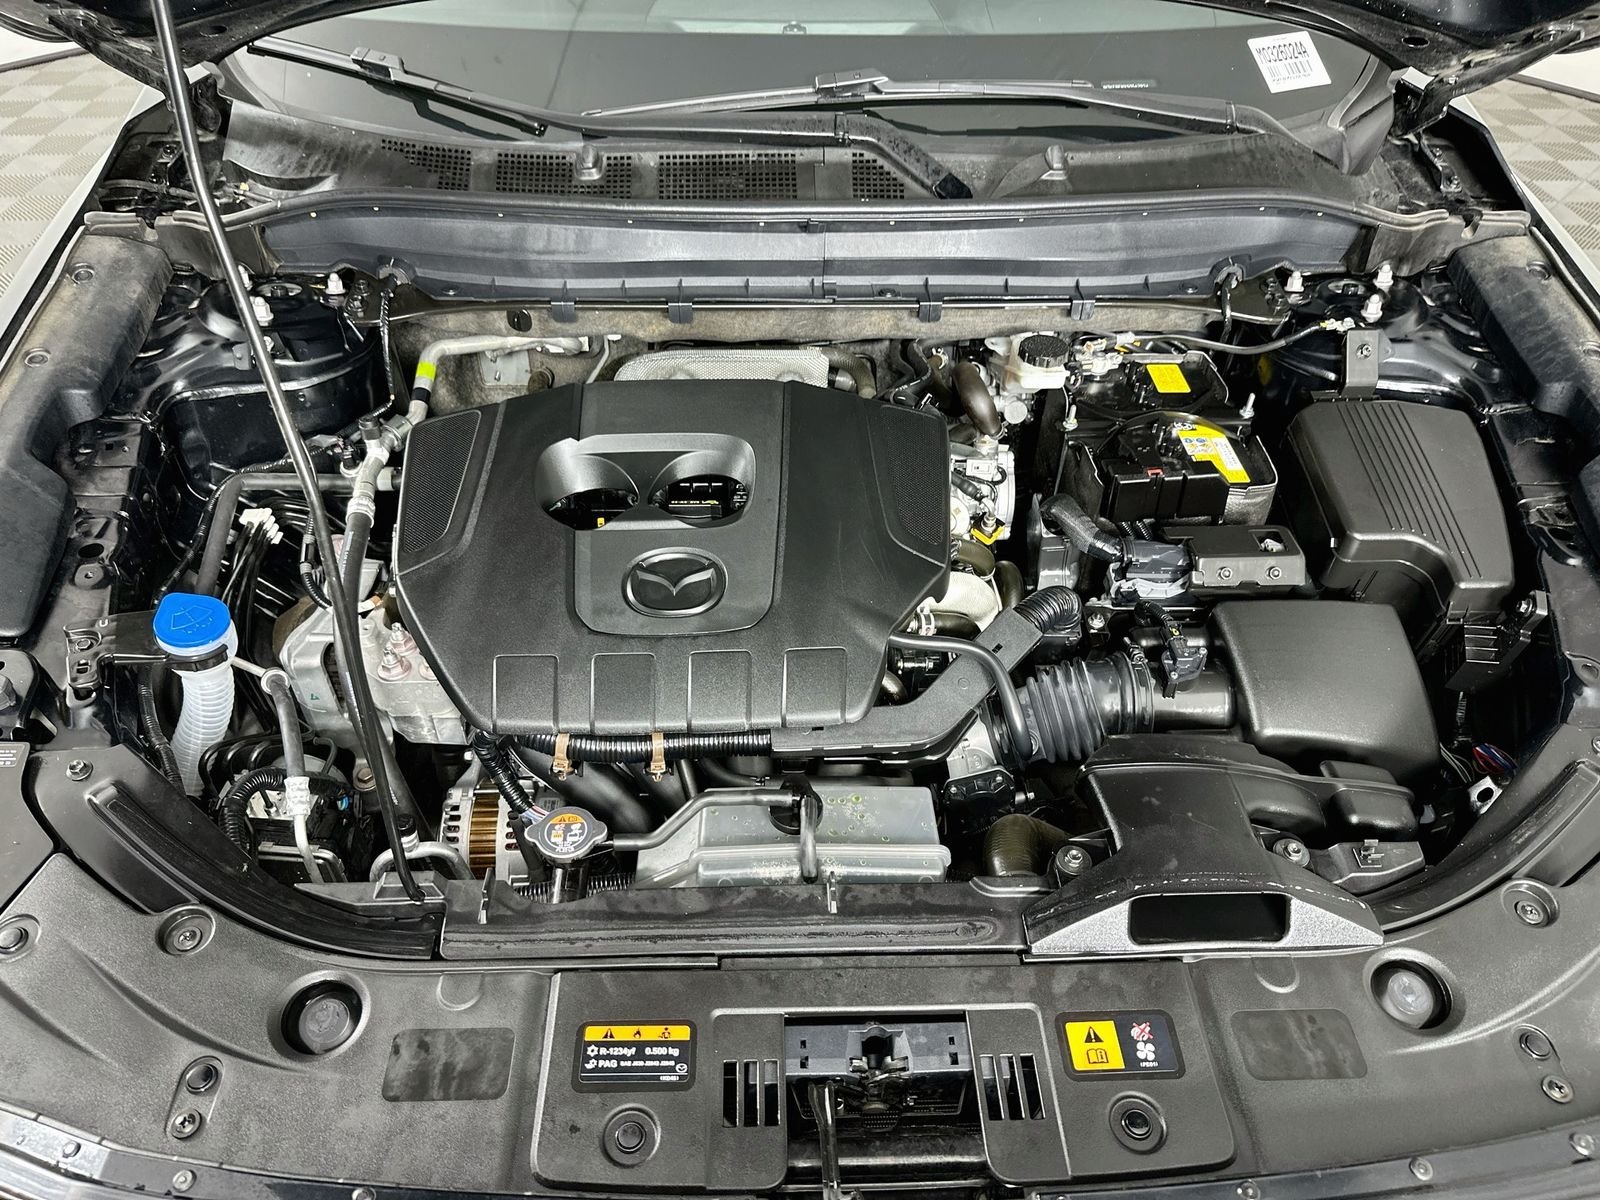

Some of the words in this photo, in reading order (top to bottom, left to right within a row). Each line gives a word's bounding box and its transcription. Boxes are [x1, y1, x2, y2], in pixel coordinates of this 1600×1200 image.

[599, 1046, 637, 1057] R-1234yf
[644, 1046, 667, 1056] 0.500
[668, 1046, 680, 1057] kg
[598, 1059, 618, 1068] PAG
